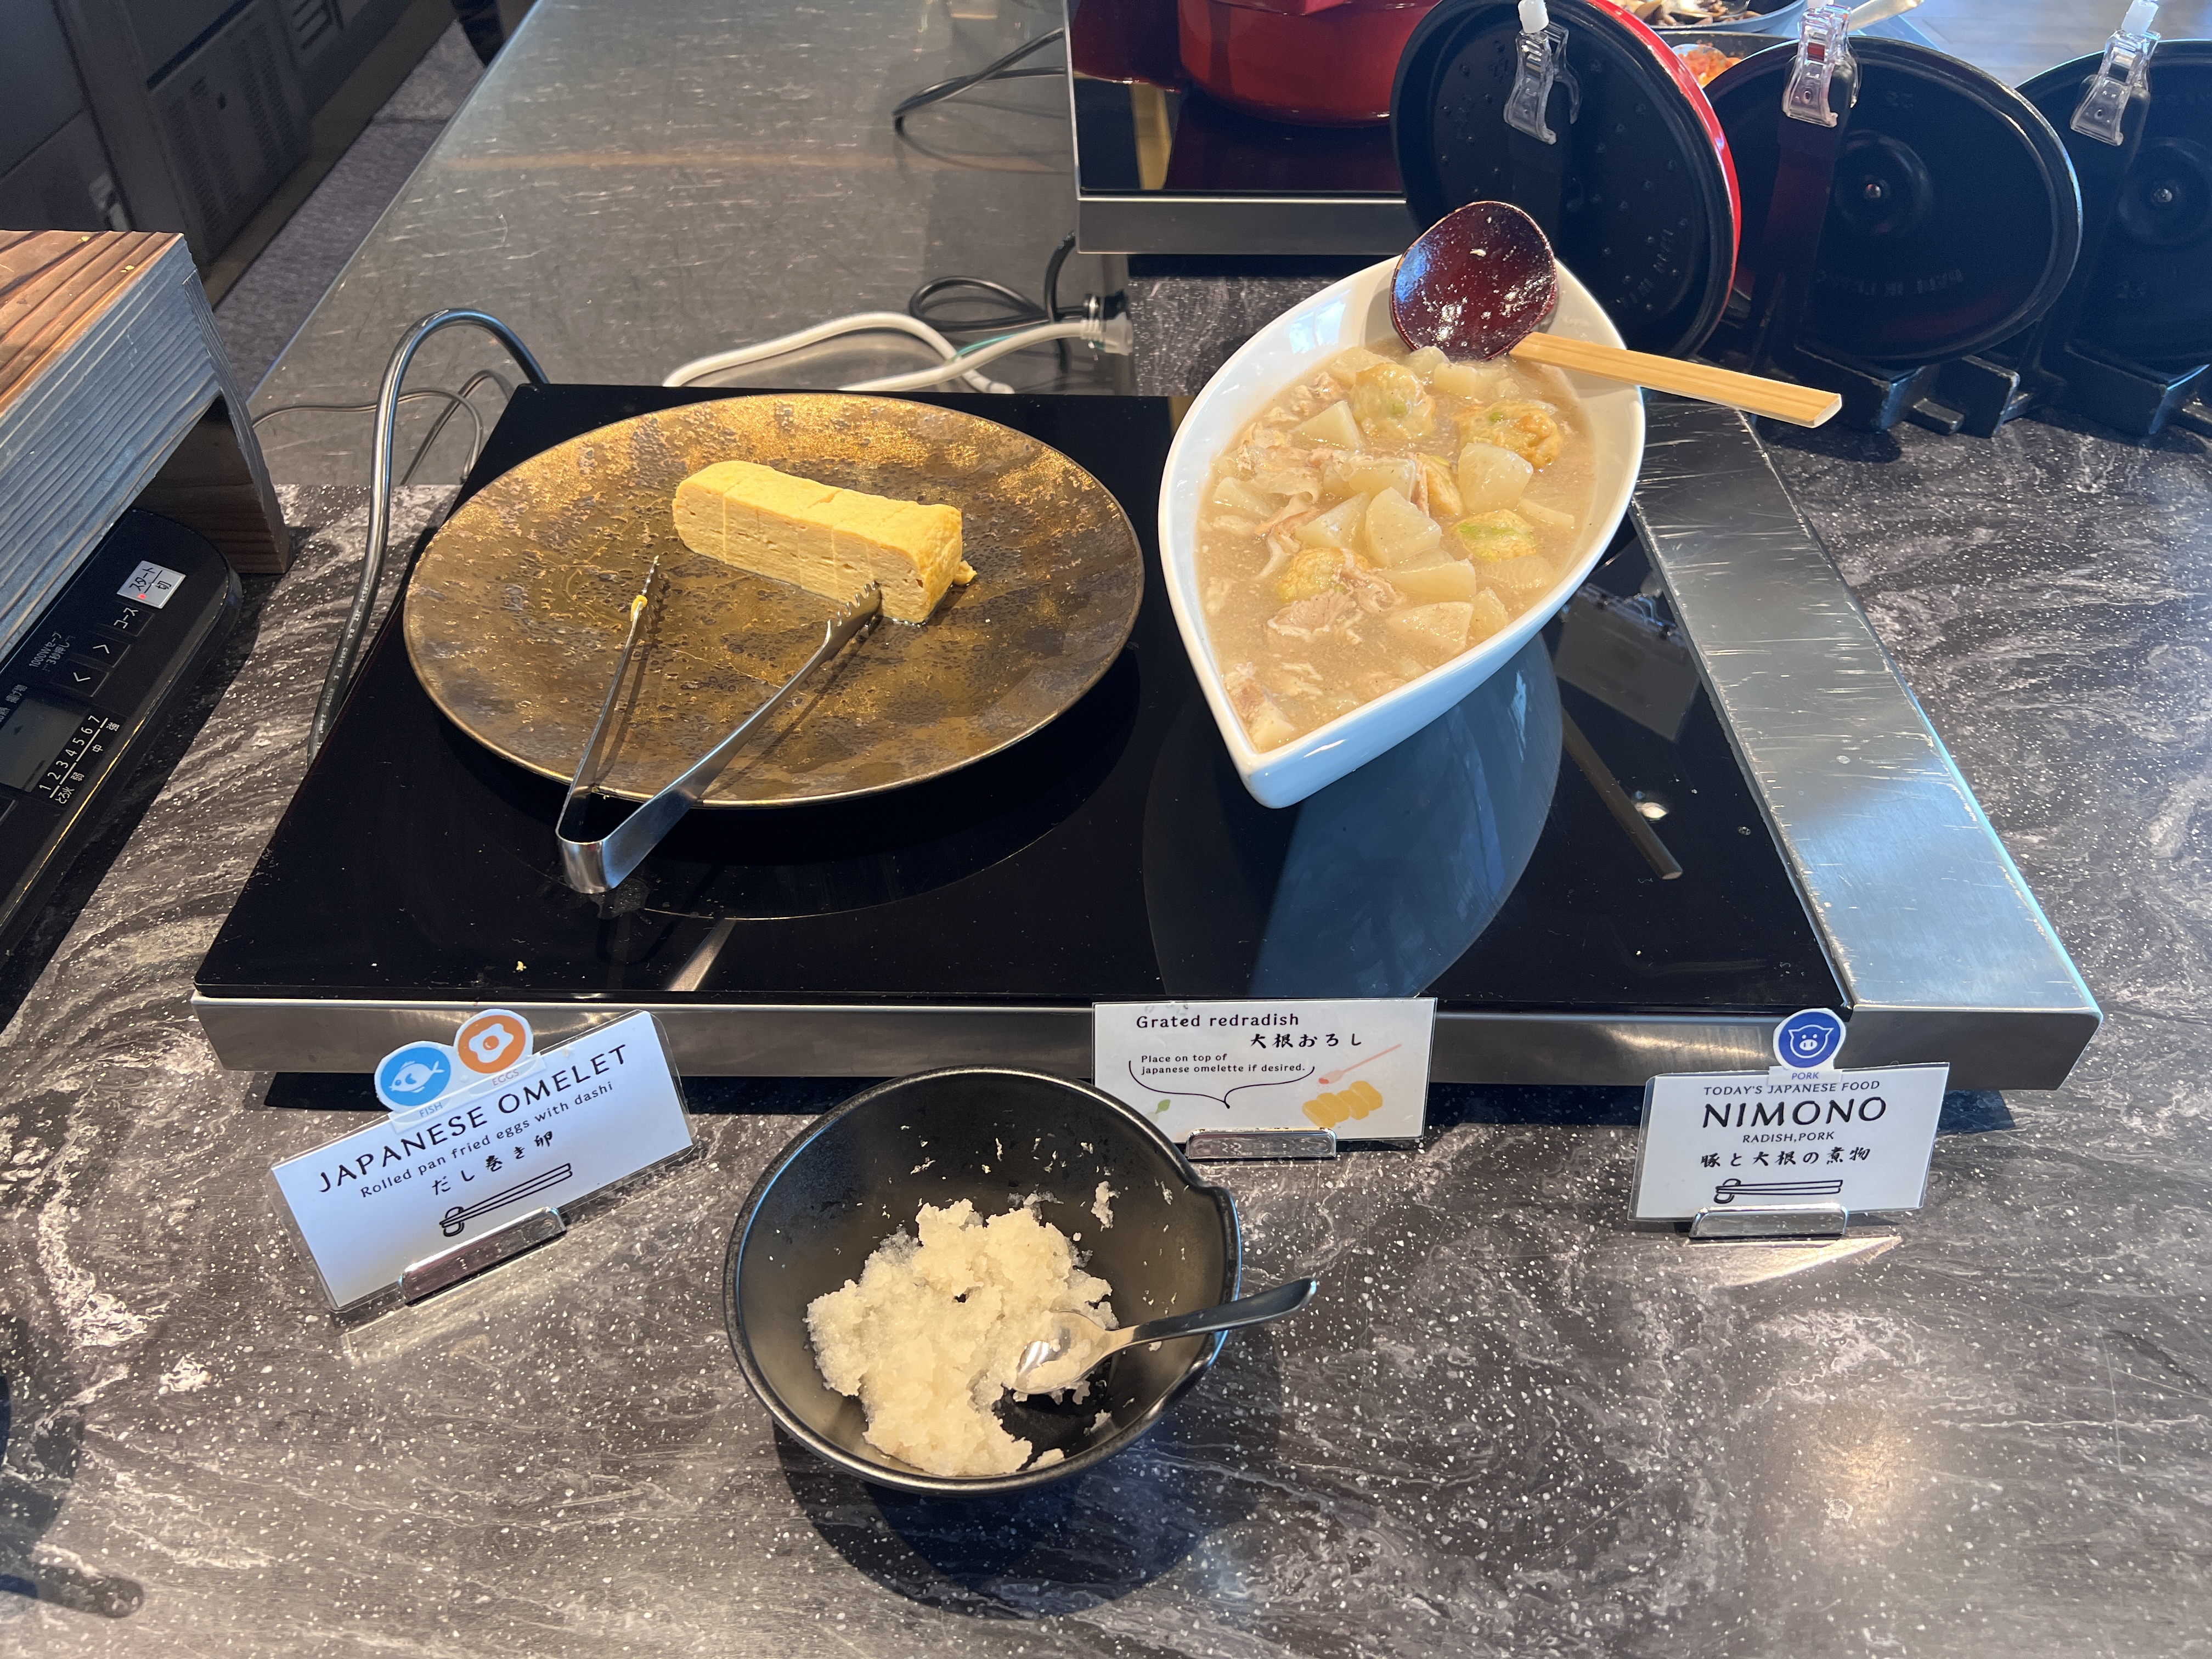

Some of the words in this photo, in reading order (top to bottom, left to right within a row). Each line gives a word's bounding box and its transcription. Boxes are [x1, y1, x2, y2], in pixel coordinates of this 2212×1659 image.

[129, 567, 156, 591] スタート
[155, 580, 172, 590] 切
[114, 607, 139, 629] コース
[47, 772, 61, 780] 2
[56, 760, 69, 769] 3
[72, 737, 85, 746] 5
[88, 715, 100, 723] 7
[92, 744, 104, 753] 中
[1136, 1014, 1200, 1028] Grated
[1209, 1013, 1299, 1027] redradish
[1250, 1032, 1362, 1049] 大根おろし
[1192, 1053, 1211, 1064] top
[1215, 1053, 1227, 1062] of
[492, 1069, 520, 1086] EGGS
[1141, 1066, 1189, 1075] japanese
[1261, 1063, 1305, 1072] desired.
[1791, 1072, 1819, 1080] PORK
[1703, 1086, 1763, 1096] TODAY'S
[1768, 1083, 1836, 1094] JAPANESE
[1842, 1081, 1880, 1091] FOOD
[319, 1106, 488, 1193] JAPANESE
[498, 1044, 626, 1114] OMELET
[419, 1102, 443, 1118] FISH
[1702, 1097, 1886, 1128] NIMONO
[360, 1169, 411, 1198] Rolled
[417, 1156, 446, 1176] pan
[451, 1135, 490, 1159] fried
[496, 1120, 530, 1139] eggs
[534, 1102, 569, 1122] with
[574, 1081, 613, 1105] dashi
[1742, 1131, 1835, 1143] RADISH,PORK
[432, 1131, 552, 1195] だし巻き卵
[1701, 1147, 1871, 1168] 豚と大根の煮物
